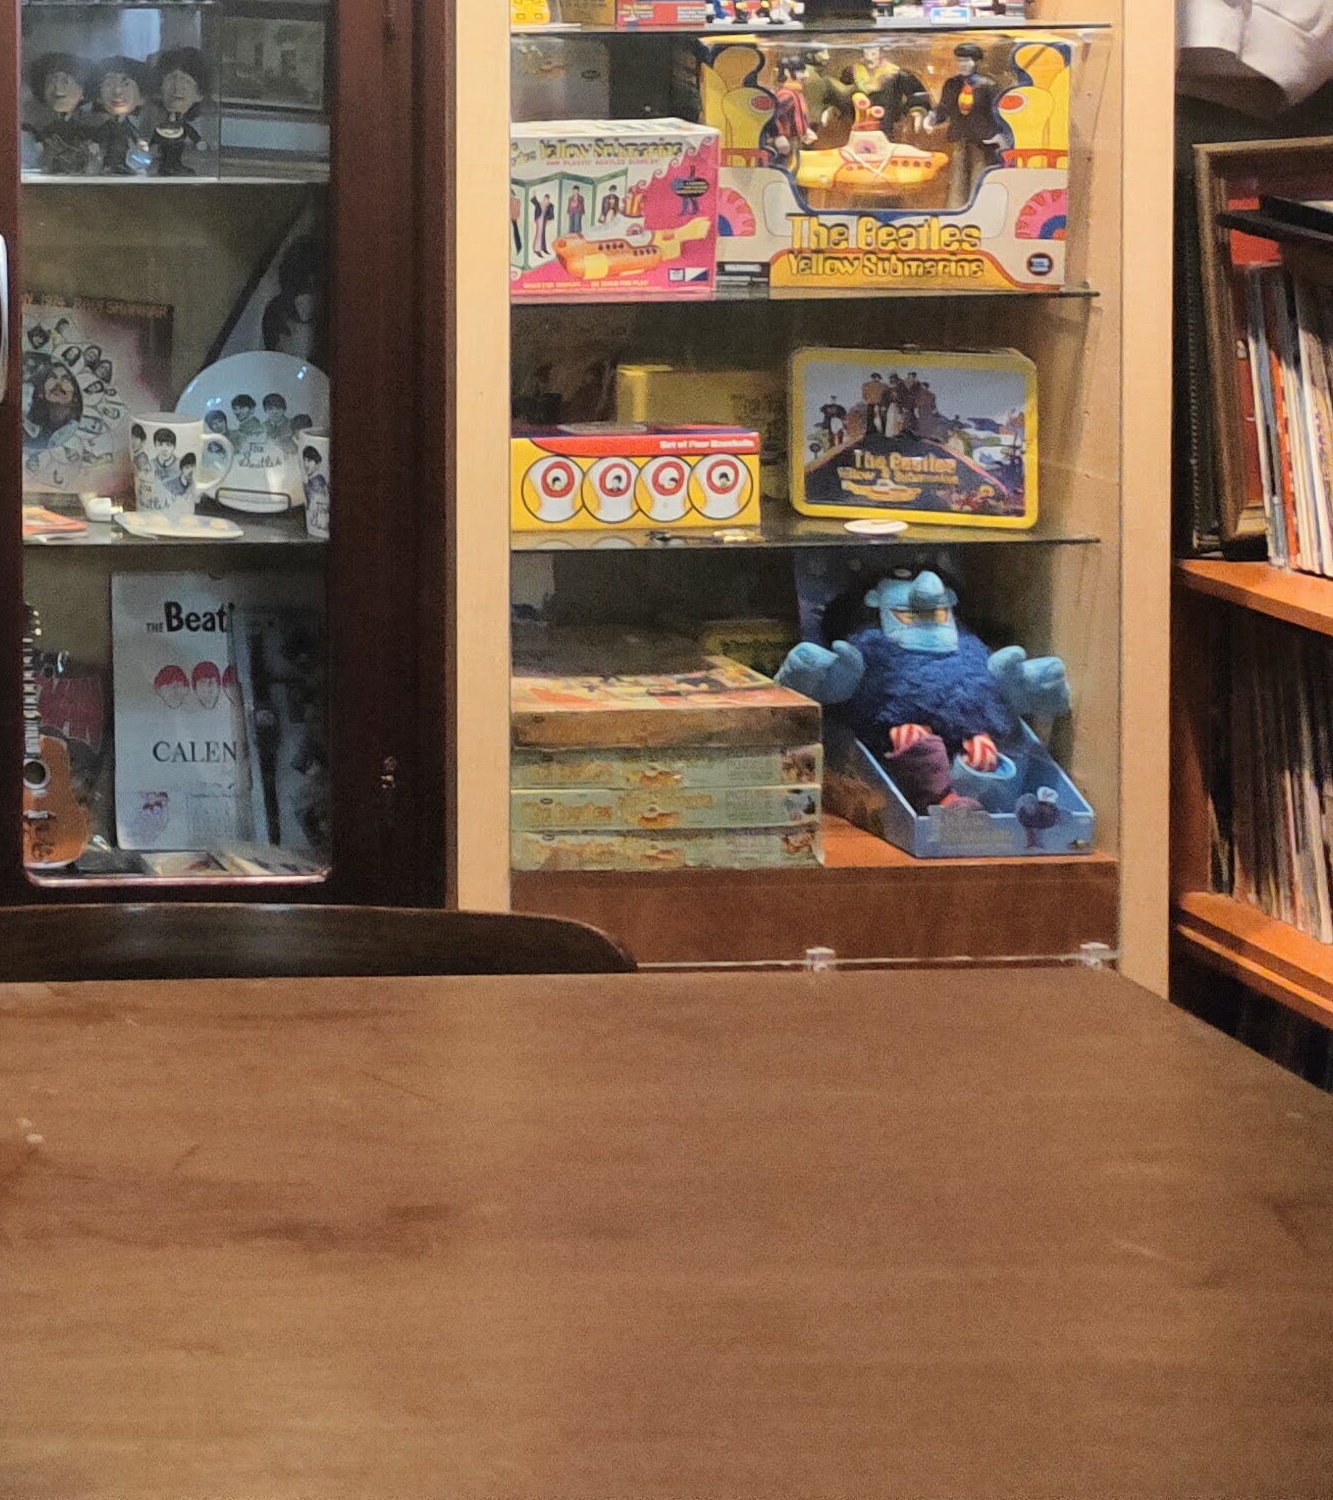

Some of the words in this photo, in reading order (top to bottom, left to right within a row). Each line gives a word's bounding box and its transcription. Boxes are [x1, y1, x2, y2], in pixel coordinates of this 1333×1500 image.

[786, 213, 850, 250] The
[856, 214, 982, 251] Beatles
[787, 251, 862, 278] Yellow
[862, 250, 985, 278] Submarine
[163, 601, 236, 633] Beat
[152, 740, 237, 763] CALEN
